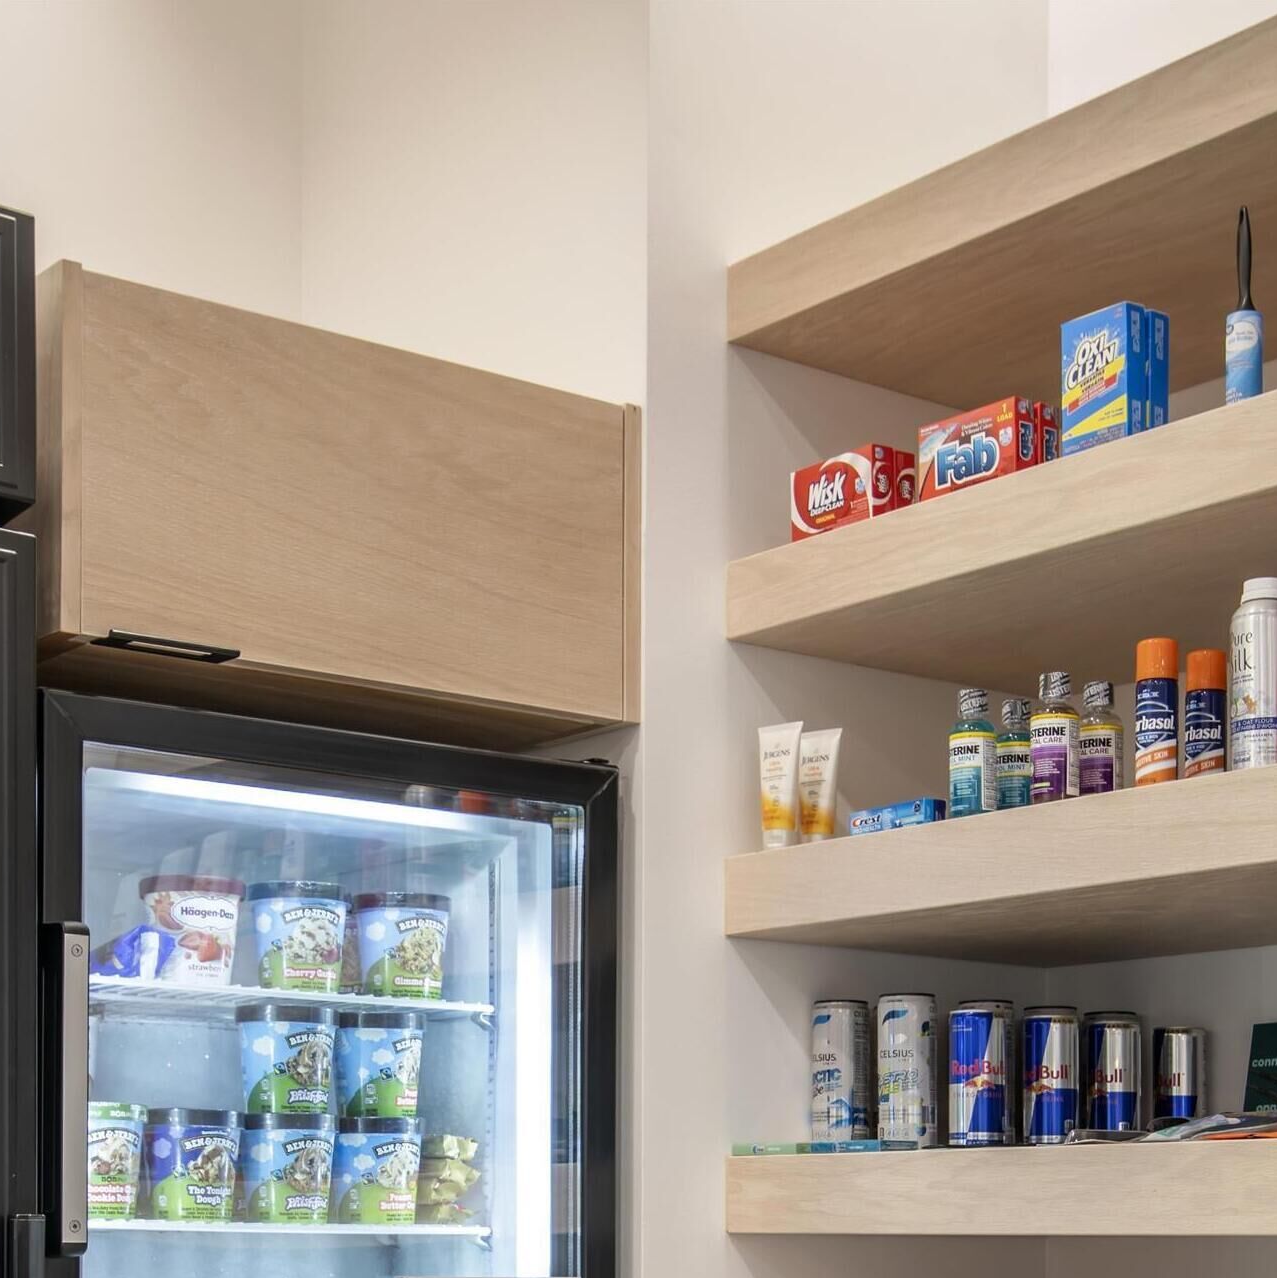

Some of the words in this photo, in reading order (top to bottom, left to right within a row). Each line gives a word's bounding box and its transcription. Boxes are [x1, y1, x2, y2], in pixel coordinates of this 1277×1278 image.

[1077, 331, 1107, 364] OXI
[1067, 342, 1116, 390] CLEAN
[936, 433, 998, 488] Fab
[808, 472, 847, 511] Wisk
[764, 749, 790, 761] JERGENS
[852, 813, 881, 827] Crest
[284, 911, 303, 922] BEN
[285, 968, 316, 978] Cherry
[289, 1035, 308, 1046] BEN
[880, 1049, 914, 1059] CELSIUS
[951, 1060, 979, 1076] Red
[1040, 1063, 1068, 1081] Bull
[187, 1186, 205, 1195] The
[196, 1195, 222, 1205] Dough
